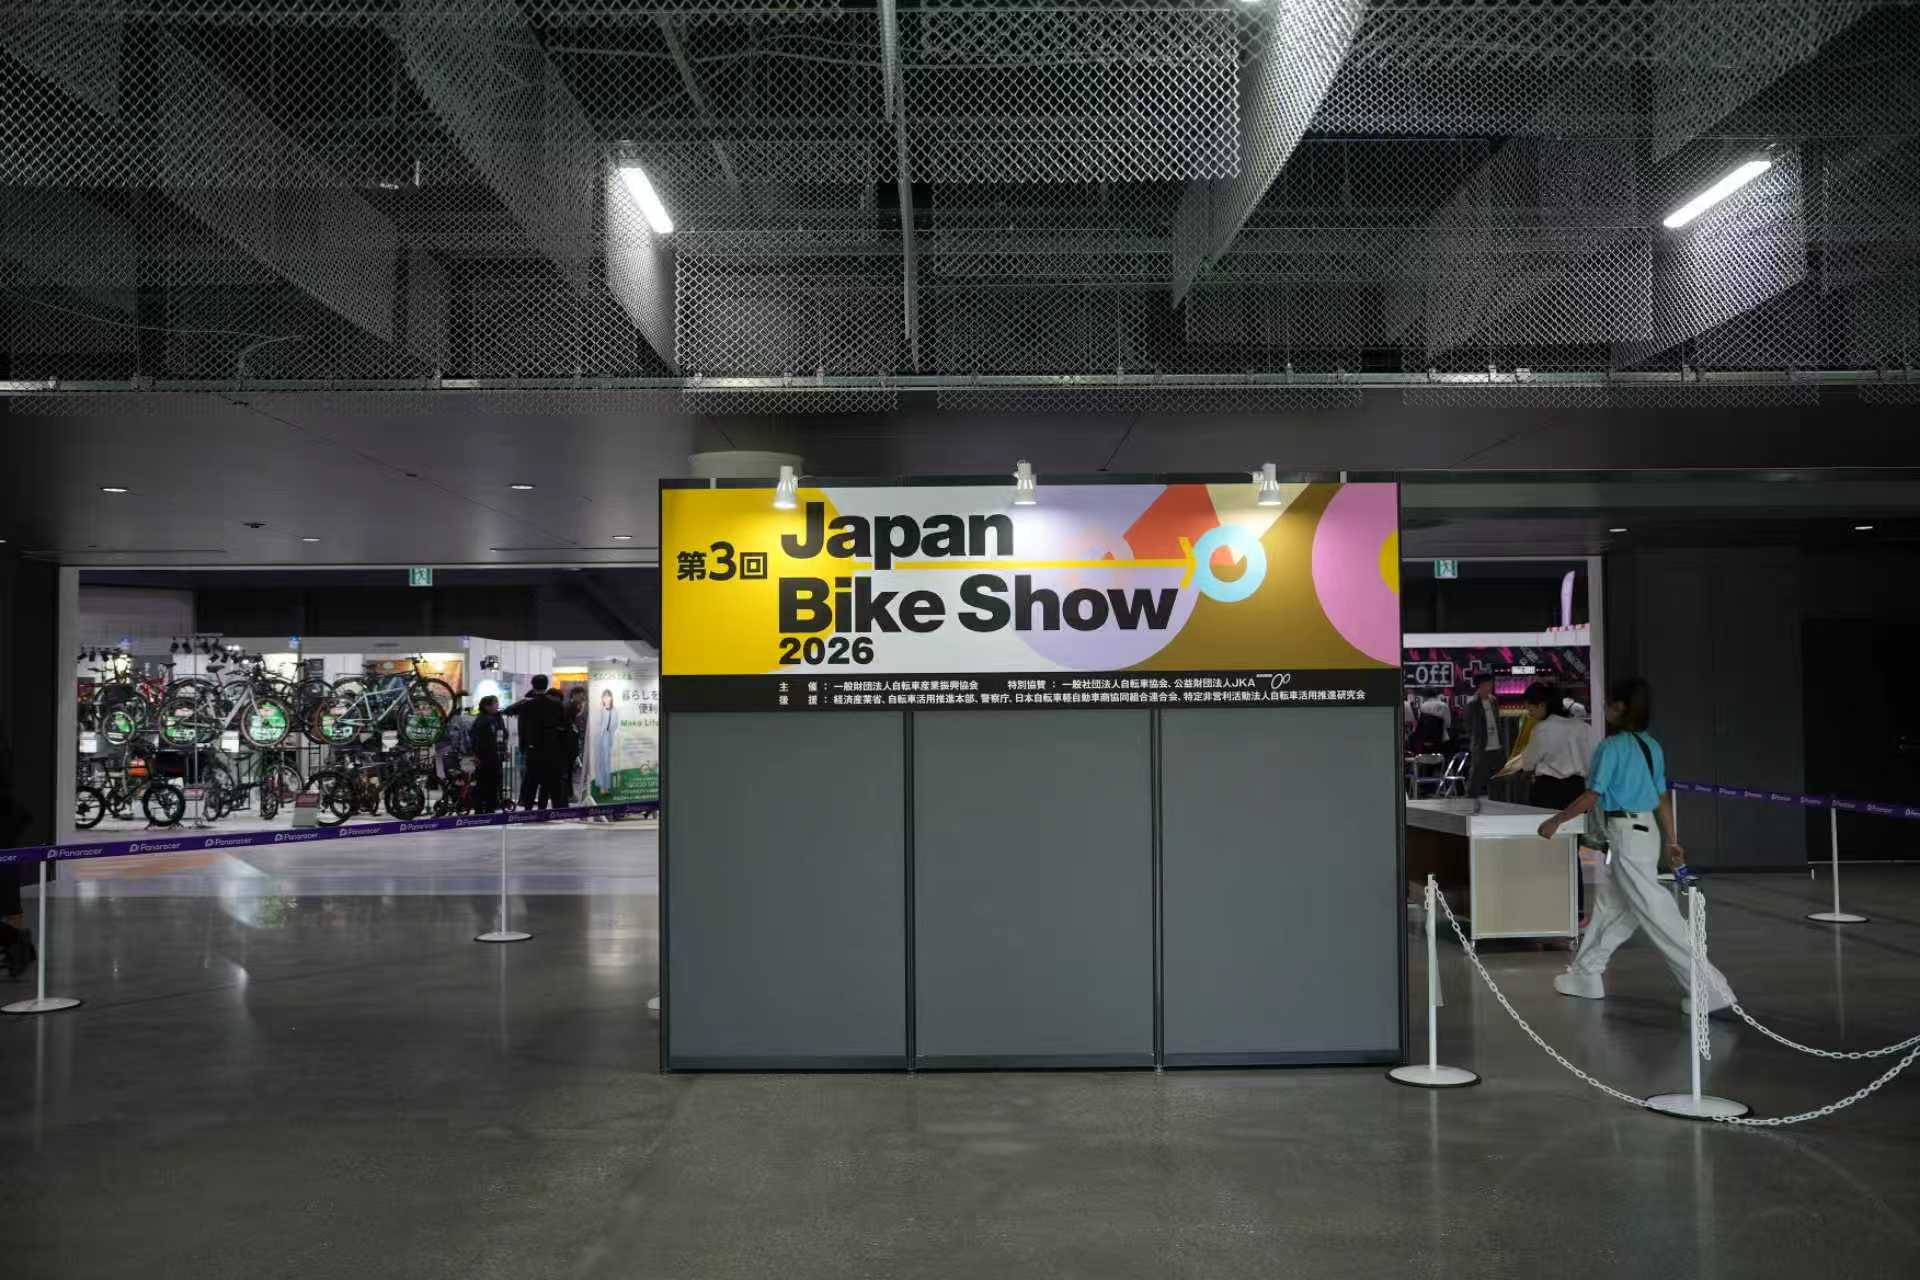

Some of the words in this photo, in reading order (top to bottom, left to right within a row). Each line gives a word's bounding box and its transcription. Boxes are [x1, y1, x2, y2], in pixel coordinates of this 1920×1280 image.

[780, 501, 1014, 571] Japan
[676, 541, 768, 581] 第3回
[778, 575, 946, 633] Bike
[957, 573, 1179, 632] Show
[778, 636, 875, 665] 2026
[59, 848, 103, 857] Panaracer
[140, 842, 182, 851] Panaracer
